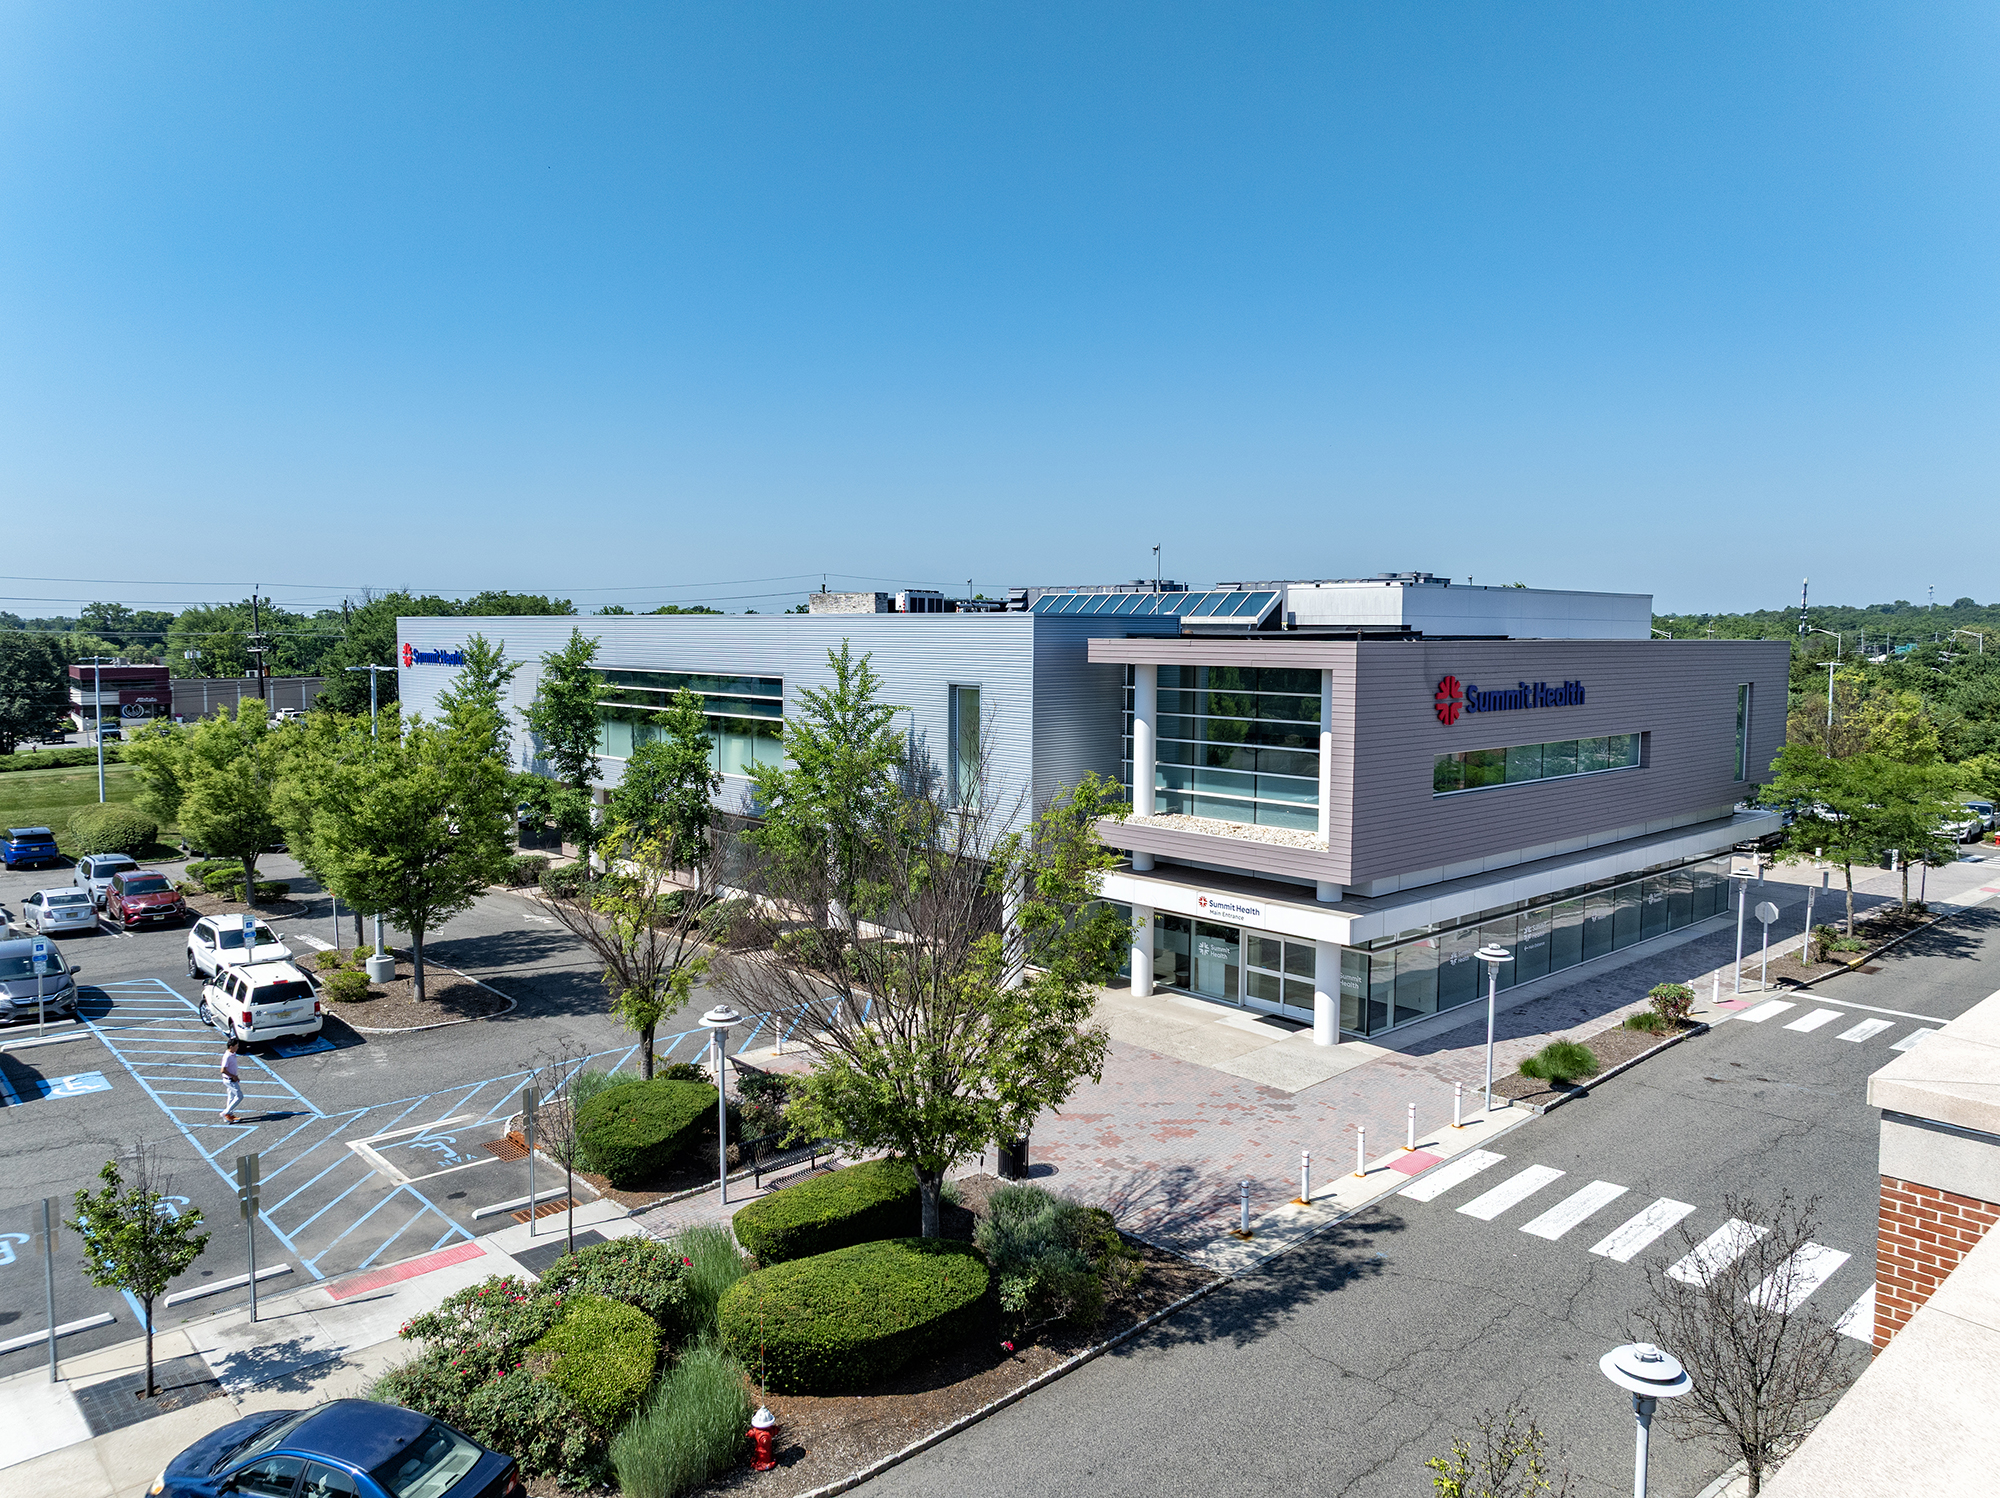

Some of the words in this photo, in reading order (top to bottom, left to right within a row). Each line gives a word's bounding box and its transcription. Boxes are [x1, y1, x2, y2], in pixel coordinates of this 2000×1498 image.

[413, 648, 440, 664] Summit
[1466, 681, 1533, 714] Summit
[1533, 680, 1586, 708] Health
[1209, 899, 1236, 912] Summit
[1236, 904, 1261, 916] Health
[1222, 911, 1245, 921] Entrance
[1210, 944, 1231, 954] Summit
[1210, 951, 1228, 960] Health
[1340, 972, 1362, 983] Summit
[437, 1153, 478, 1167] VAN
